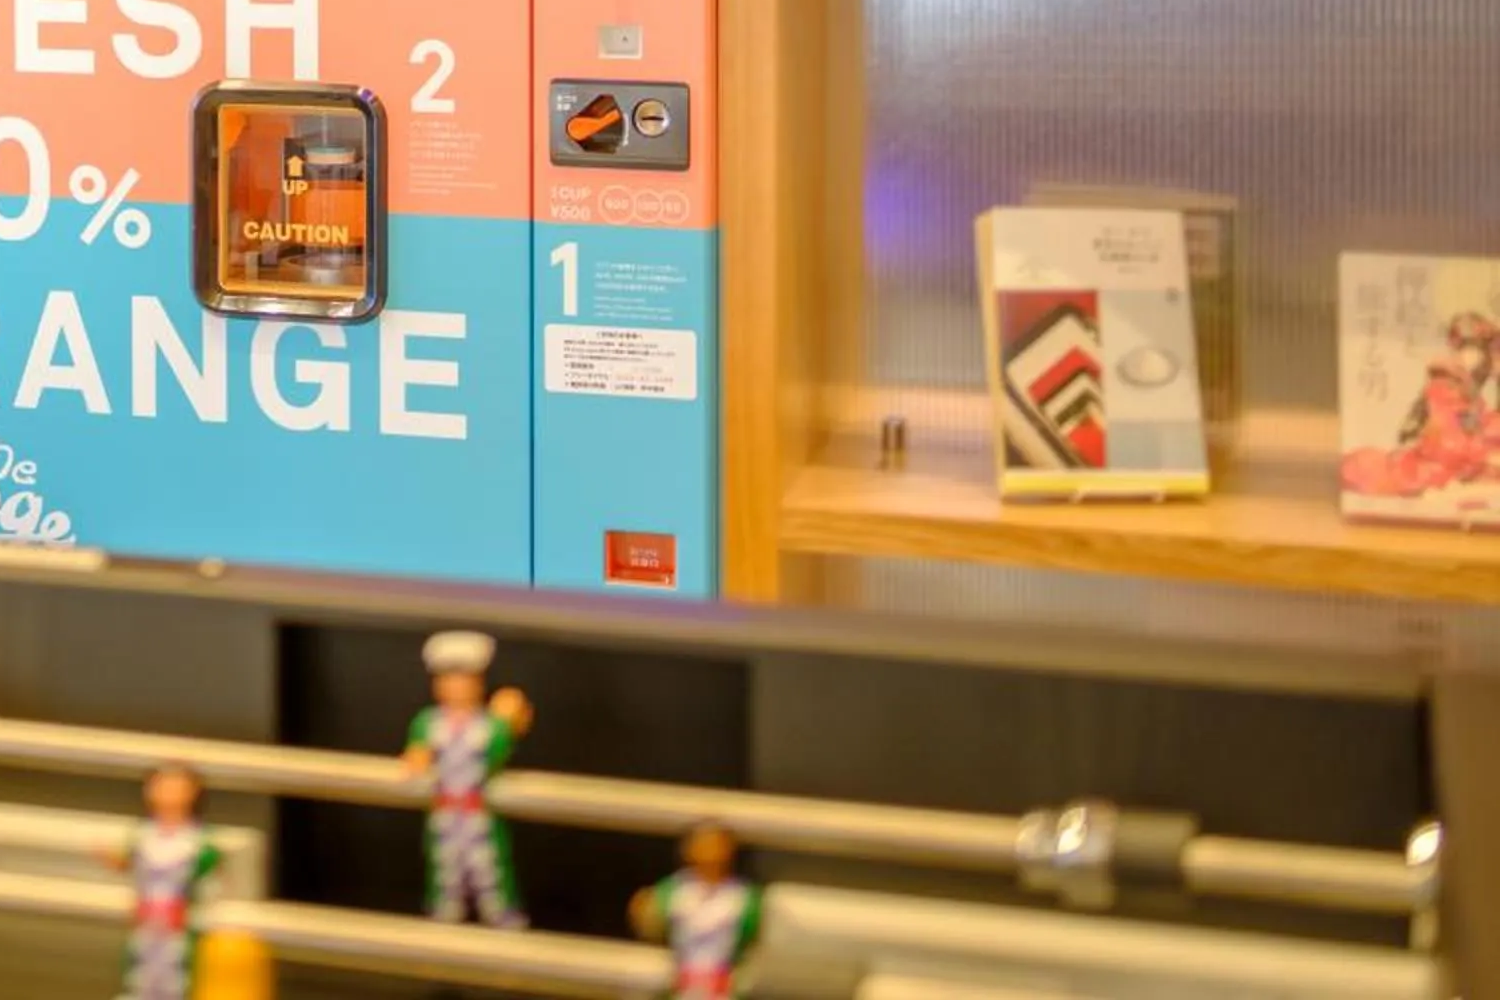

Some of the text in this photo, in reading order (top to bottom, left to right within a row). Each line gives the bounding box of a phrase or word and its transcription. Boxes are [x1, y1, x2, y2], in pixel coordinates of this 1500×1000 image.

[408, 38, 456, 114] 2
[283, 180, 309, 195] UP
[243, 221, 350, 245] CAUTION
[550, 241, 579, 316] 1
